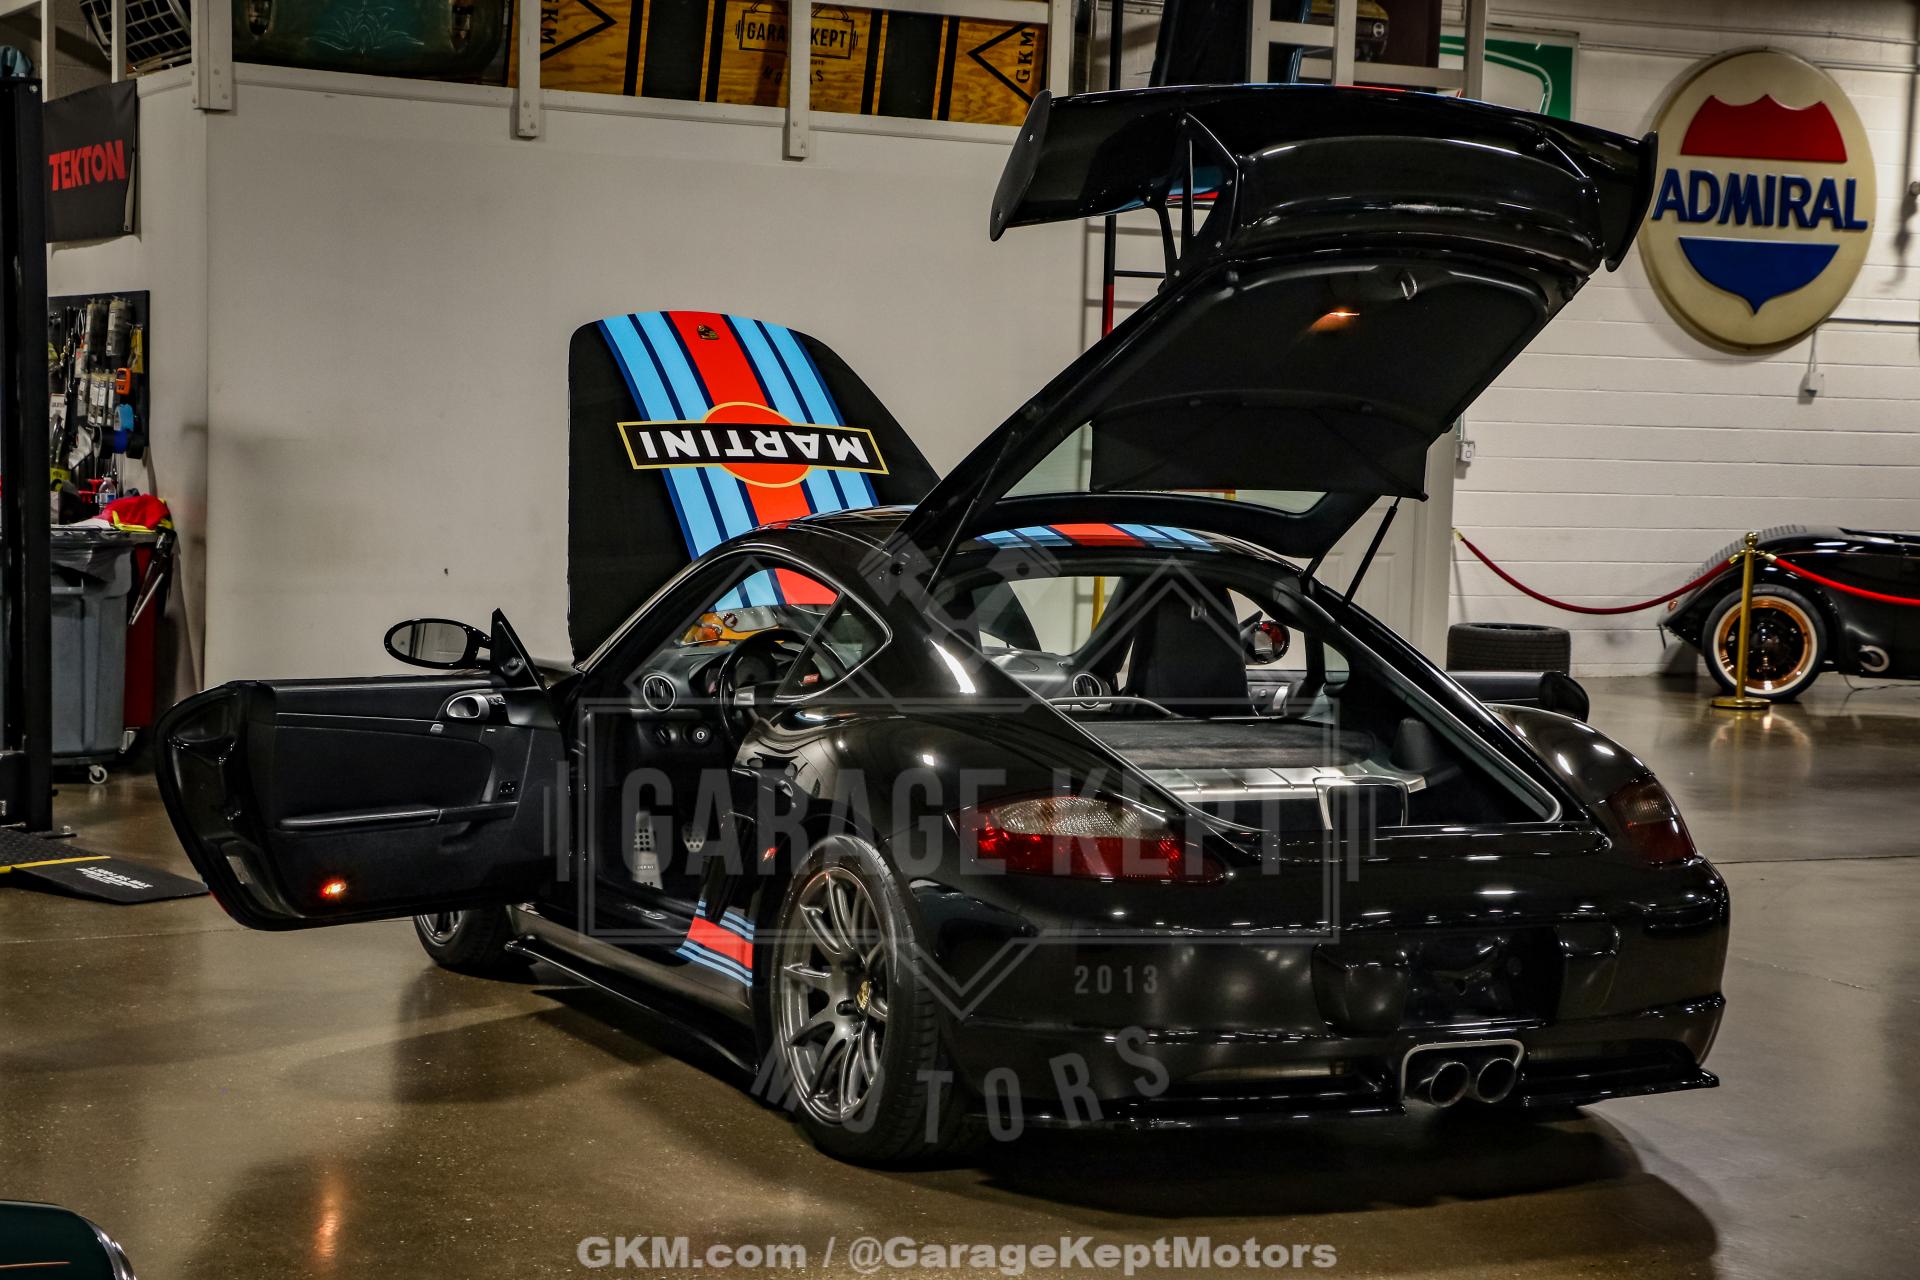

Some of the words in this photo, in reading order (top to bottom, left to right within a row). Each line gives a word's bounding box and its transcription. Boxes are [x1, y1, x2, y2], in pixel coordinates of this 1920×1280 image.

[541, 0, 559, 45] KM
[747, 22, 790, 42] GARA
[810, 27, 847, 48] KEPT
[1016, 31, 1036, 84] GKM
[48, 139, 126, 192] TEKTON
[1651, 168, 1868, 231] ADMIRAL
[639, 430, 870, 464] MARTINI
